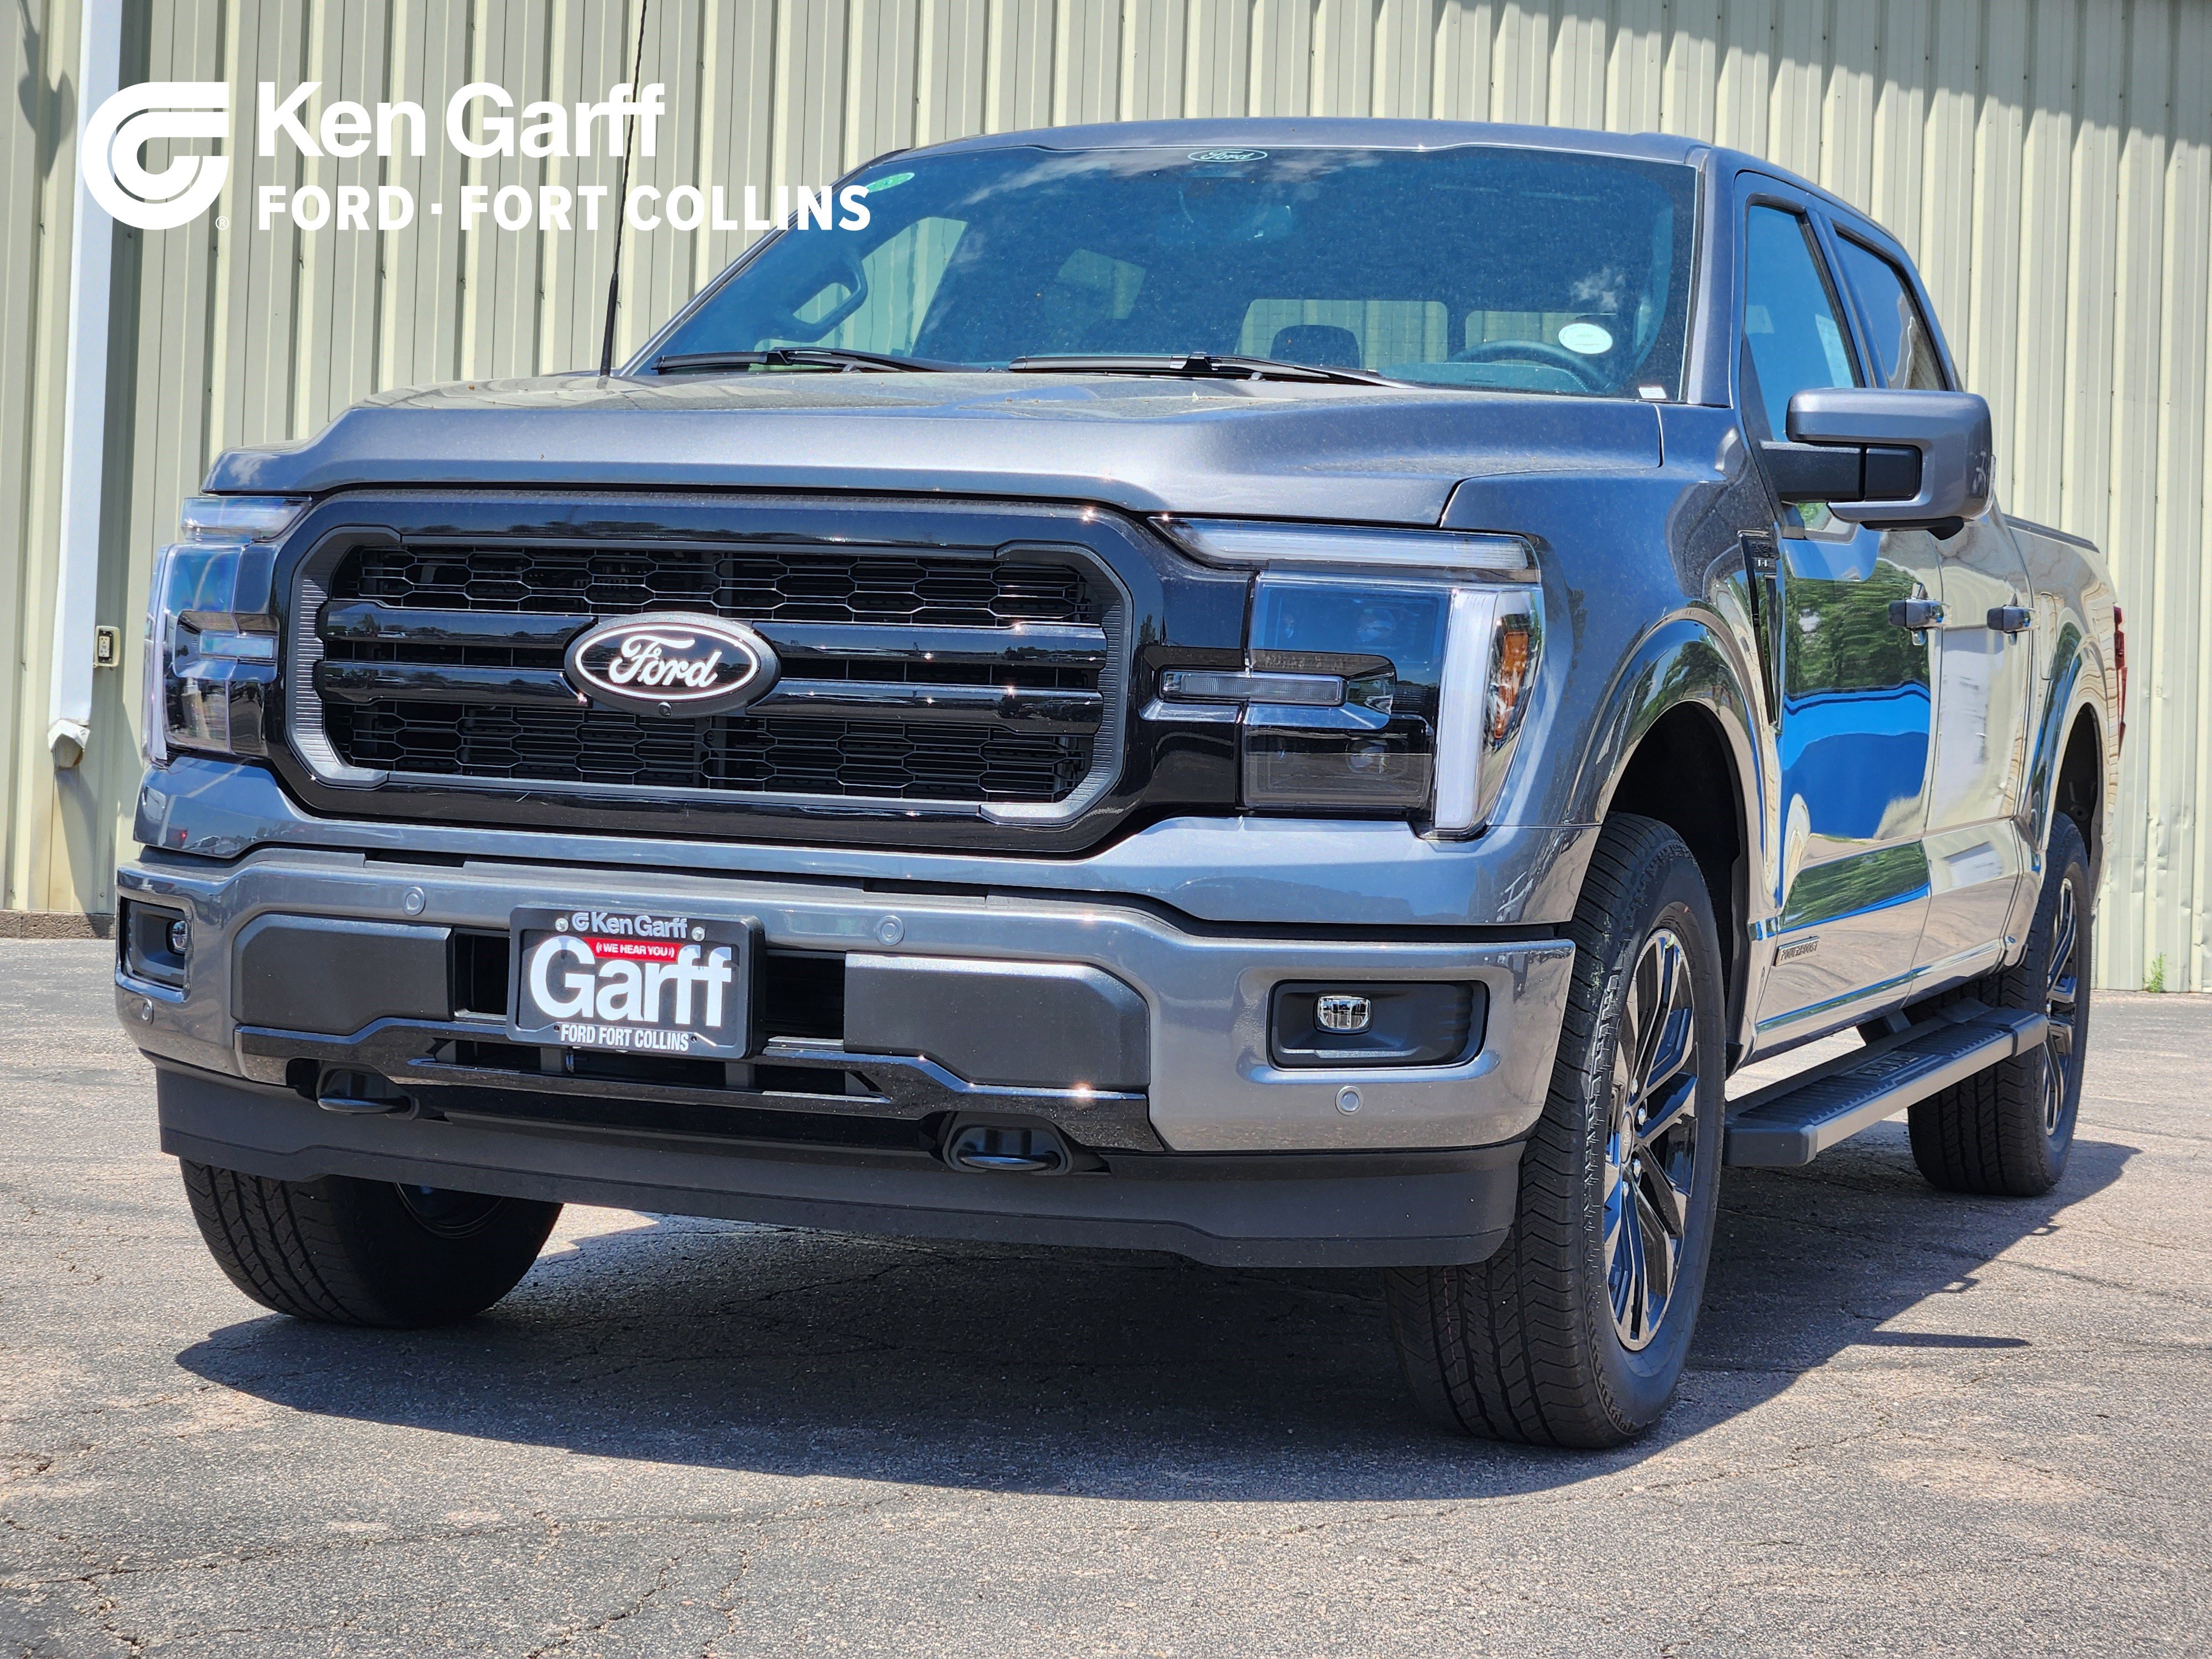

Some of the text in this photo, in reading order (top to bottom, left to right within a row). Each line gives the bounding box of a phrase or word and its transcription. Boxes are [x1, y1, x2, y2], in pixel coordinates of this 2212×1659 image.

[1201, 149, 1255, 160] Ford
[609, 635, 722, 687] Ford
[591, 911, 688, 938] Ken Garff
[603, 943, 669, 957] WE HEAR YOU
[529, 935, 732, 1027] Garff
[560, 1024, 689, 1052] FORD FORT COLLINS
